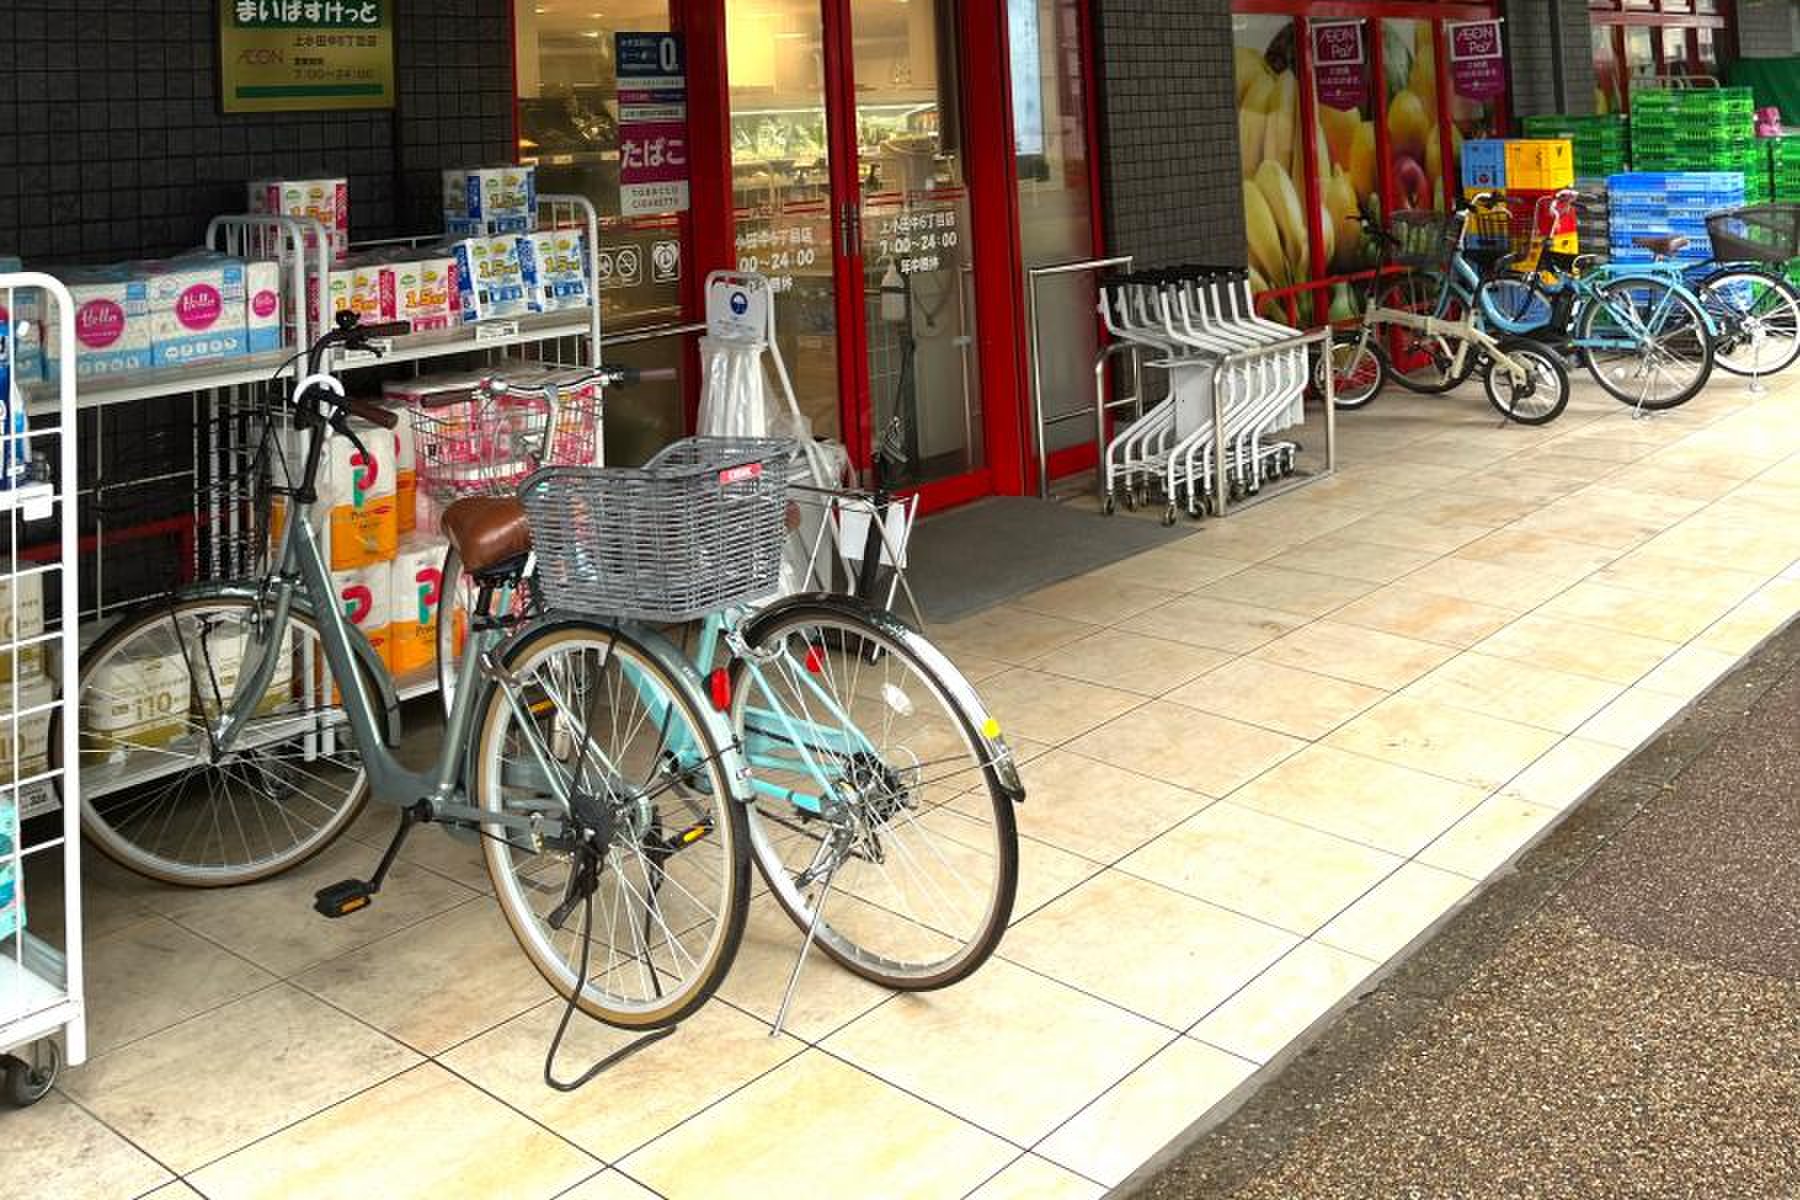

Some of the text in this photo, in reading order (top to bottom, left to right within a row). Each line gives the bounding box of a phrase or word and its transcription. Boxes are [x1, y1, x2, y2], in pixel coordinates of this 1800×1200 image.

[236, 0, 378, 23] まいばすけっと
[621, 137, 687, 169] たばこ
